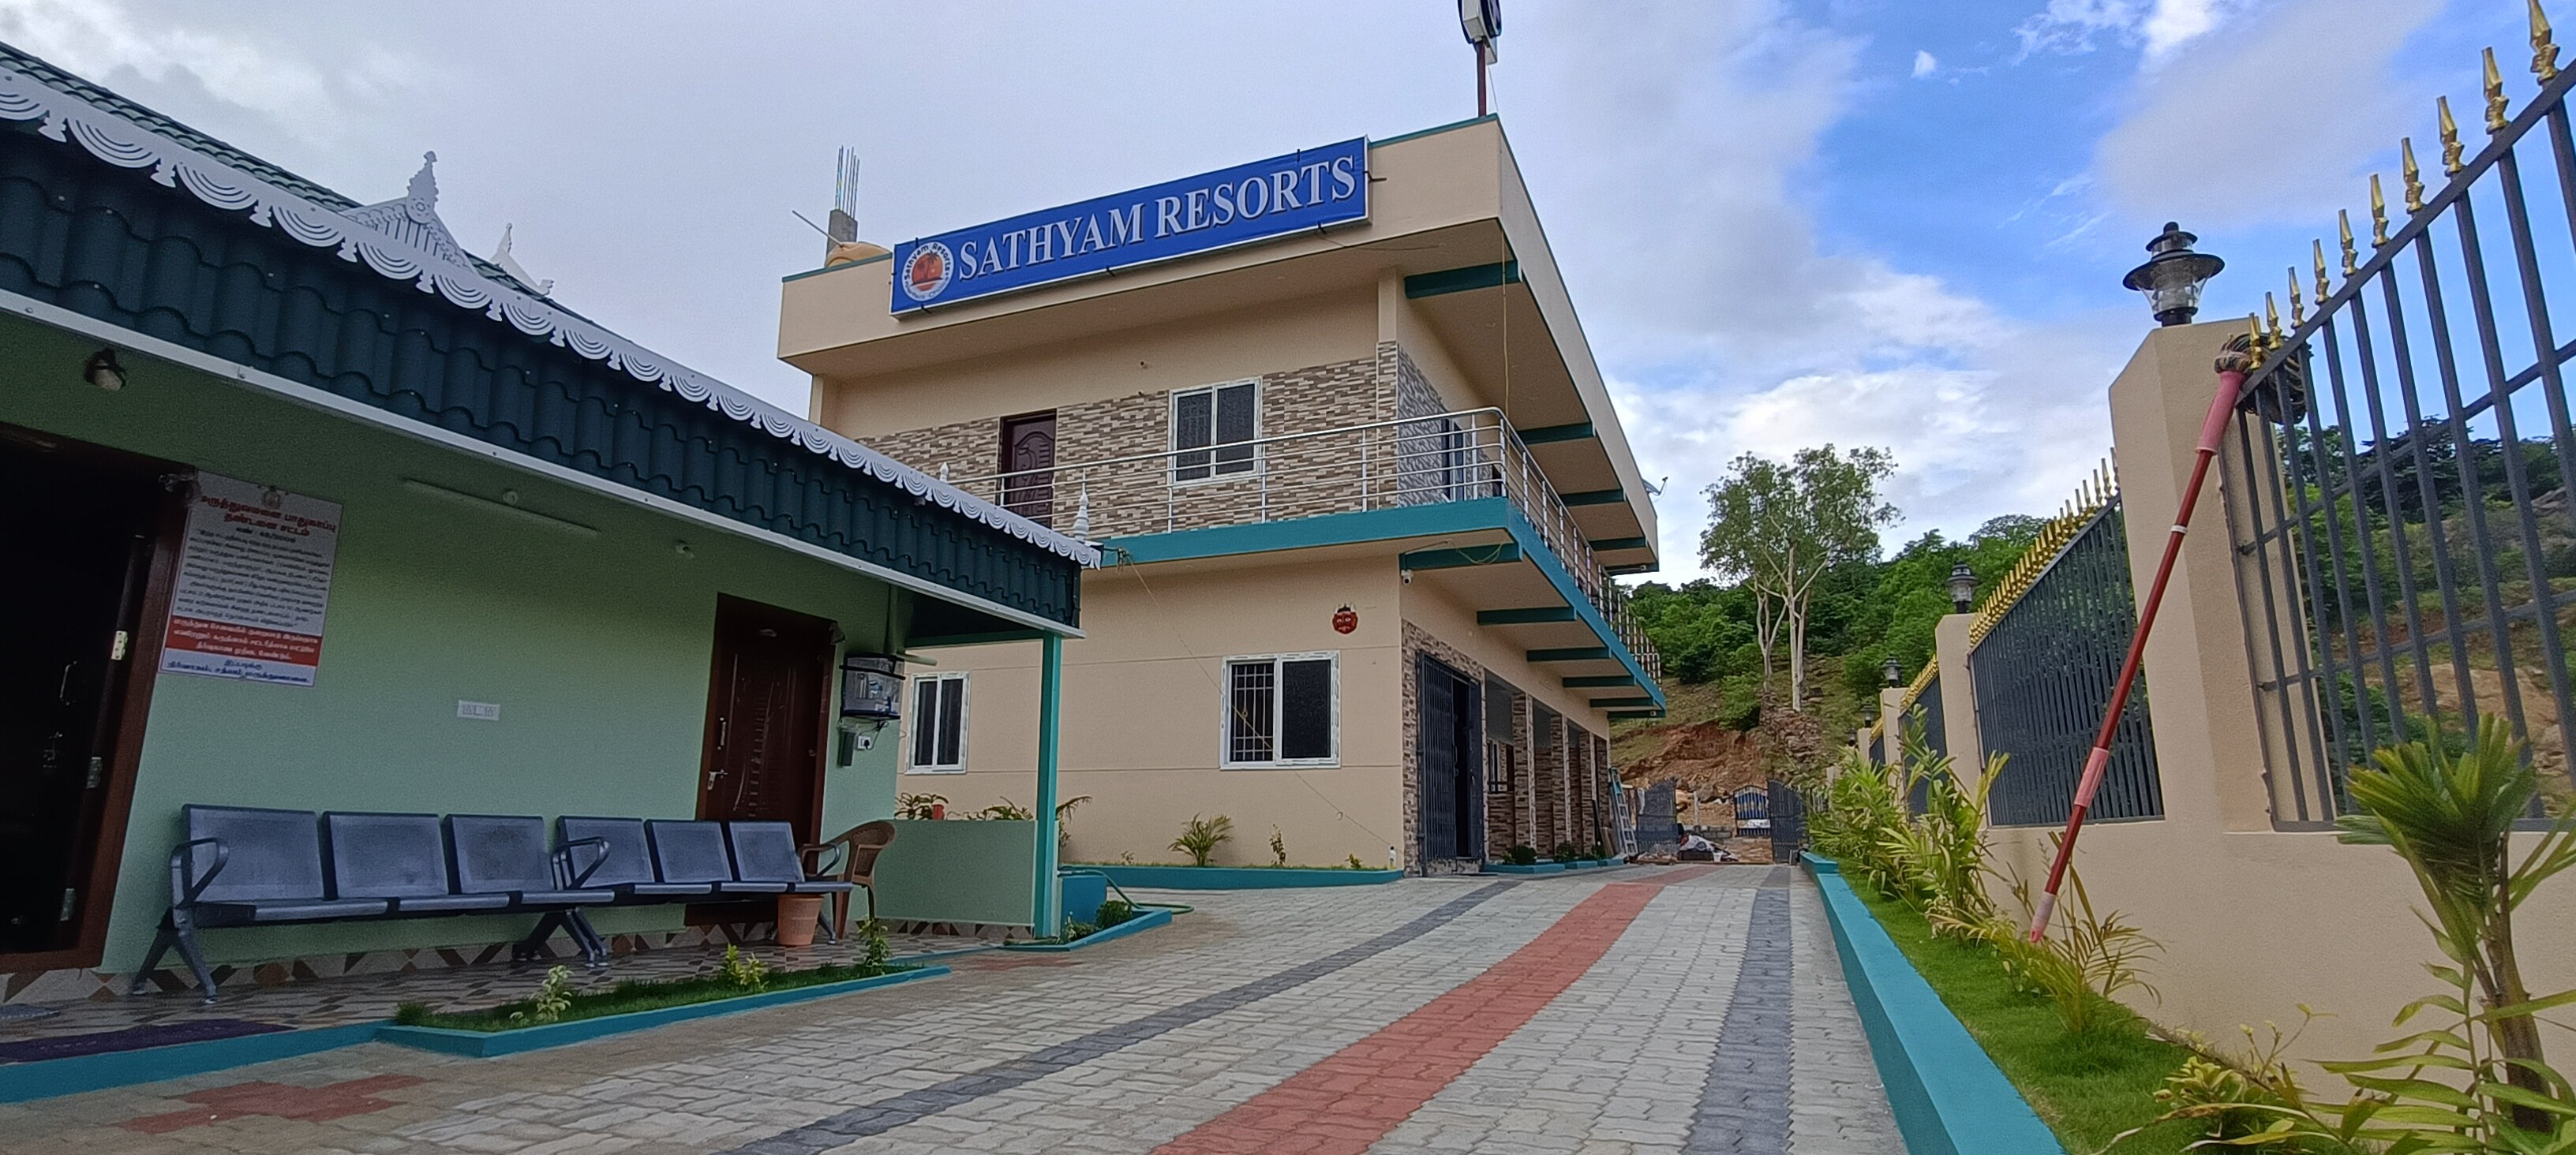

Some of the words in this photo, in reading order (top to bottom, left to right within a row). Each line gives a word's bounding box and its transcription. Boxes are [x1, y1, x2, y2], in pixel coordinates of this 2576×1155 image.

[958, 203, 1146, 281] SATHYAM
[1154, 155, 1357, 237] RESORTS
[904, 245, 929, 281] Sathyam
[932, 242, 951, 271] Resorts
[280, 524, 310, 536] சட்டம்
[284, 514, 336, 533] பாதுகாப்பு
